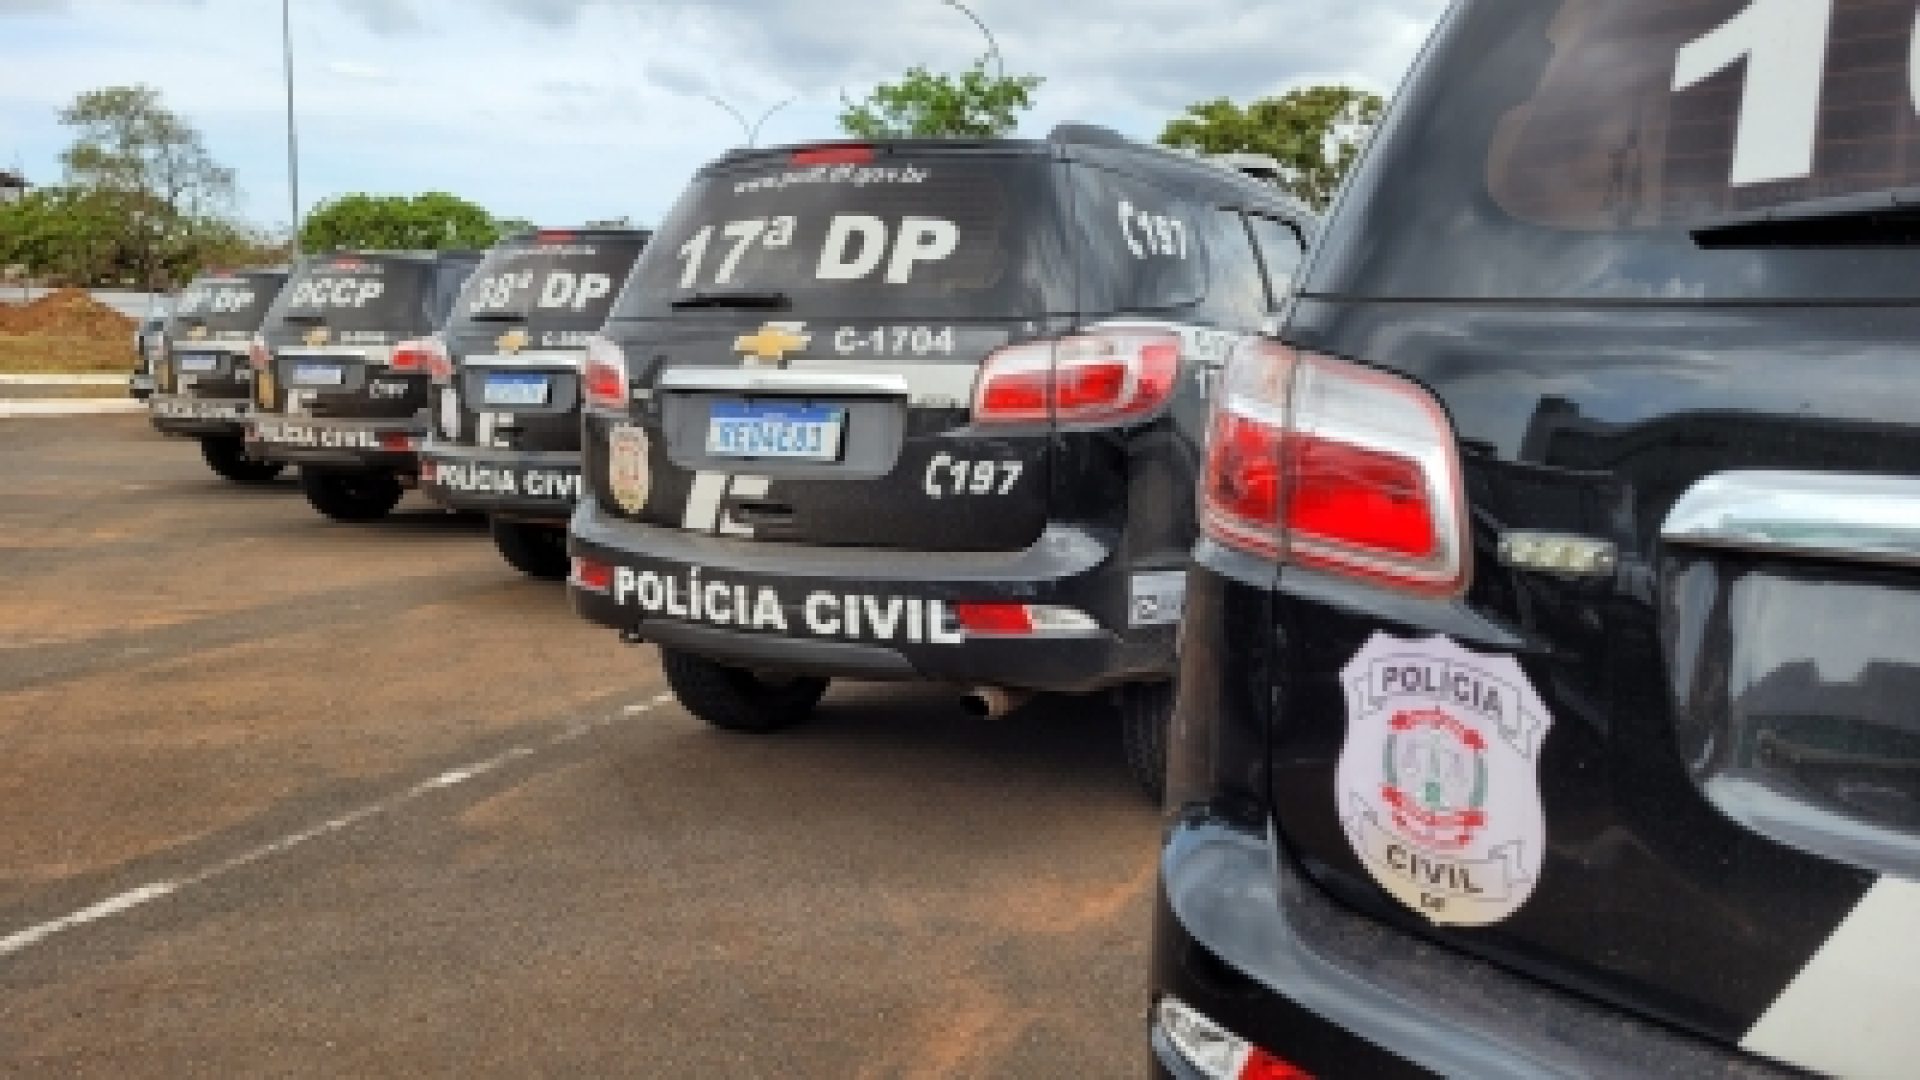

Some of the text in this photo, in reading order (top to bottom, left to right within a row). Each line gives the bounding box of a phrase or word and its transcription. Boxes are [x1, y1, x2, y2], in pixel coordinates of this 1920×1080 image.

[1670, 0, 1920, 187] 1
[815, 214, 960, 285] DP
[537, 269, 611, 312] DP
[834, 327, 955, 354] C-1704
[947, 459, 1024, 496] 197
[613, 562, 965, 644] POLÍCIA CIVIL
[1386, 844, 1484, 894] CIVIL
